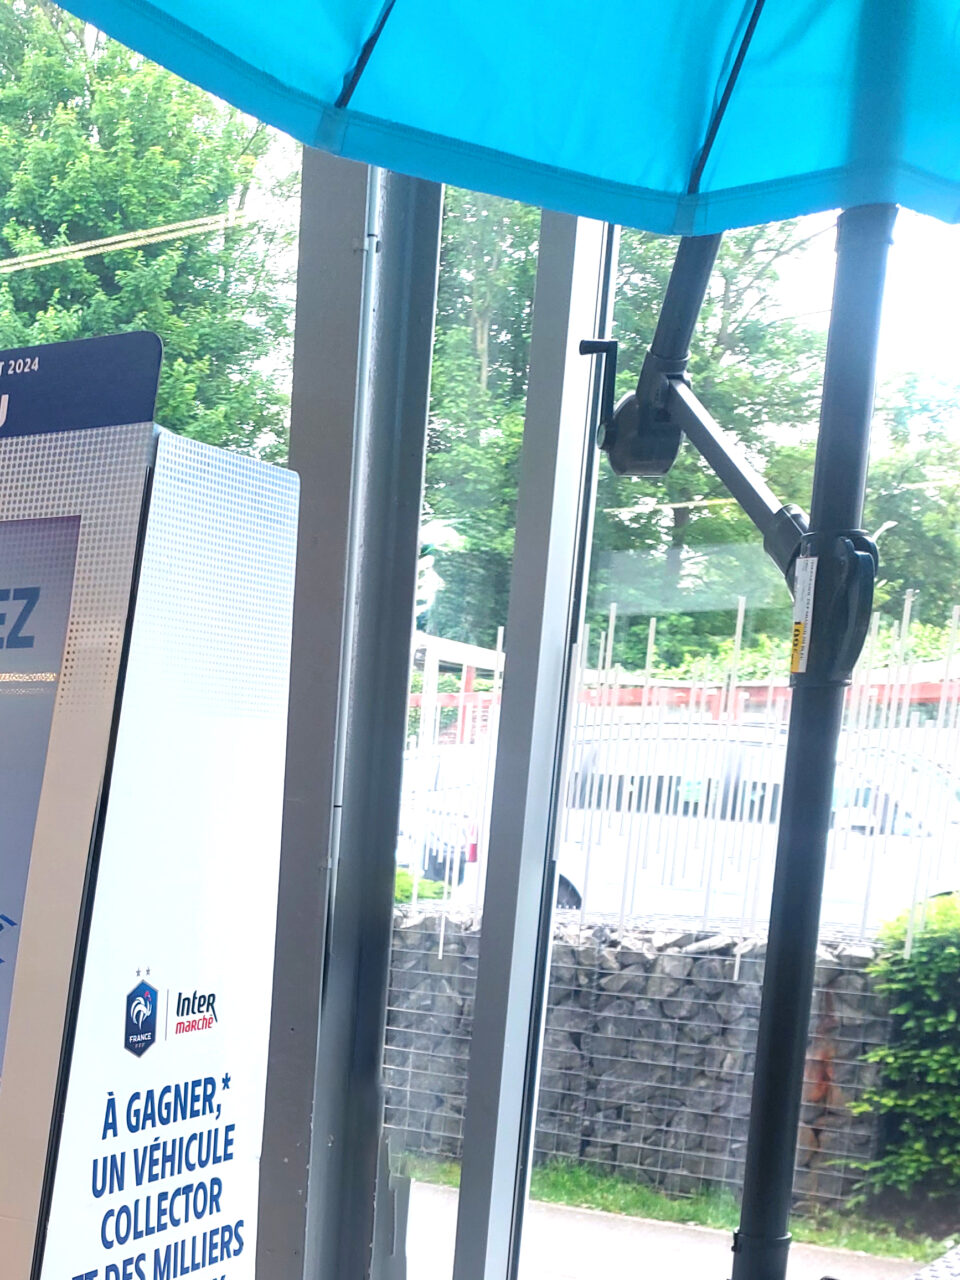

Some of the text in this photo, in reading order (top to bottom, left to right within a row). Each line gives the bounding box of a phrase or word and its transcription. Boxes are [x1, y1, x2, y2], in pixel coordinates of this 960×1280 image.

[8, 357, 39, 375] 2024
[176, 990, 218, 1023] Inter
[129, 1033, 151, 1043] FRANCE
[102, 1091, 118, 1141] À
[92, 1123, 235, 1199] UN VÉHICULE
[101, 1177, 222, 1249] COLLECTOR
